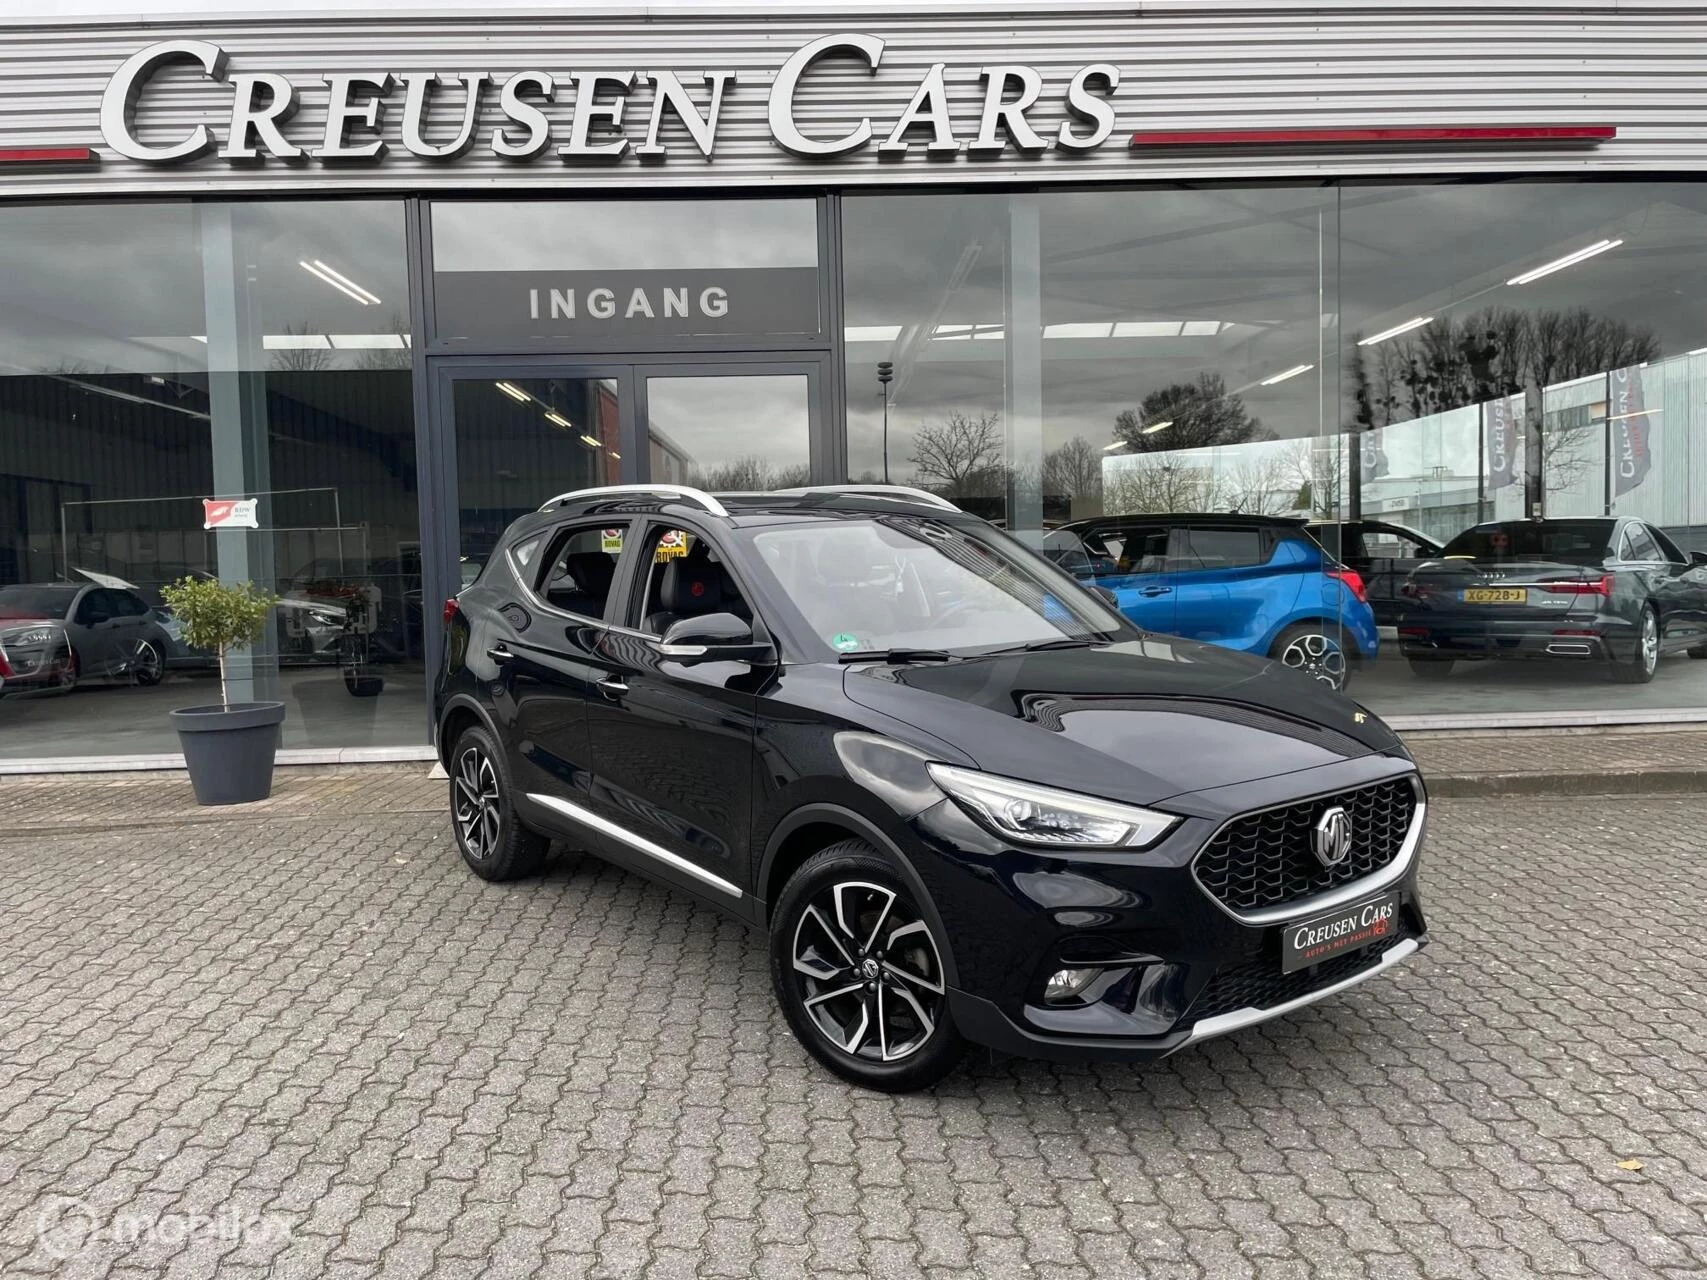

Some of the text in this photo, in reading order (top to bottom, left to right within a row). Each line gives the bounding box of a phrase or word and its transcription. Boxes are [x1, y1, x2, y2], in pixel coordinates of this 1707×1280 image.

[100, 33, 1121, 164] CREUSEN CARS
[529, 286, 728, 319] INGANG
[1467, 590, 1521, 601] XG-728-J
[1293, 902, 1393, 950] CREUSEN CARS
